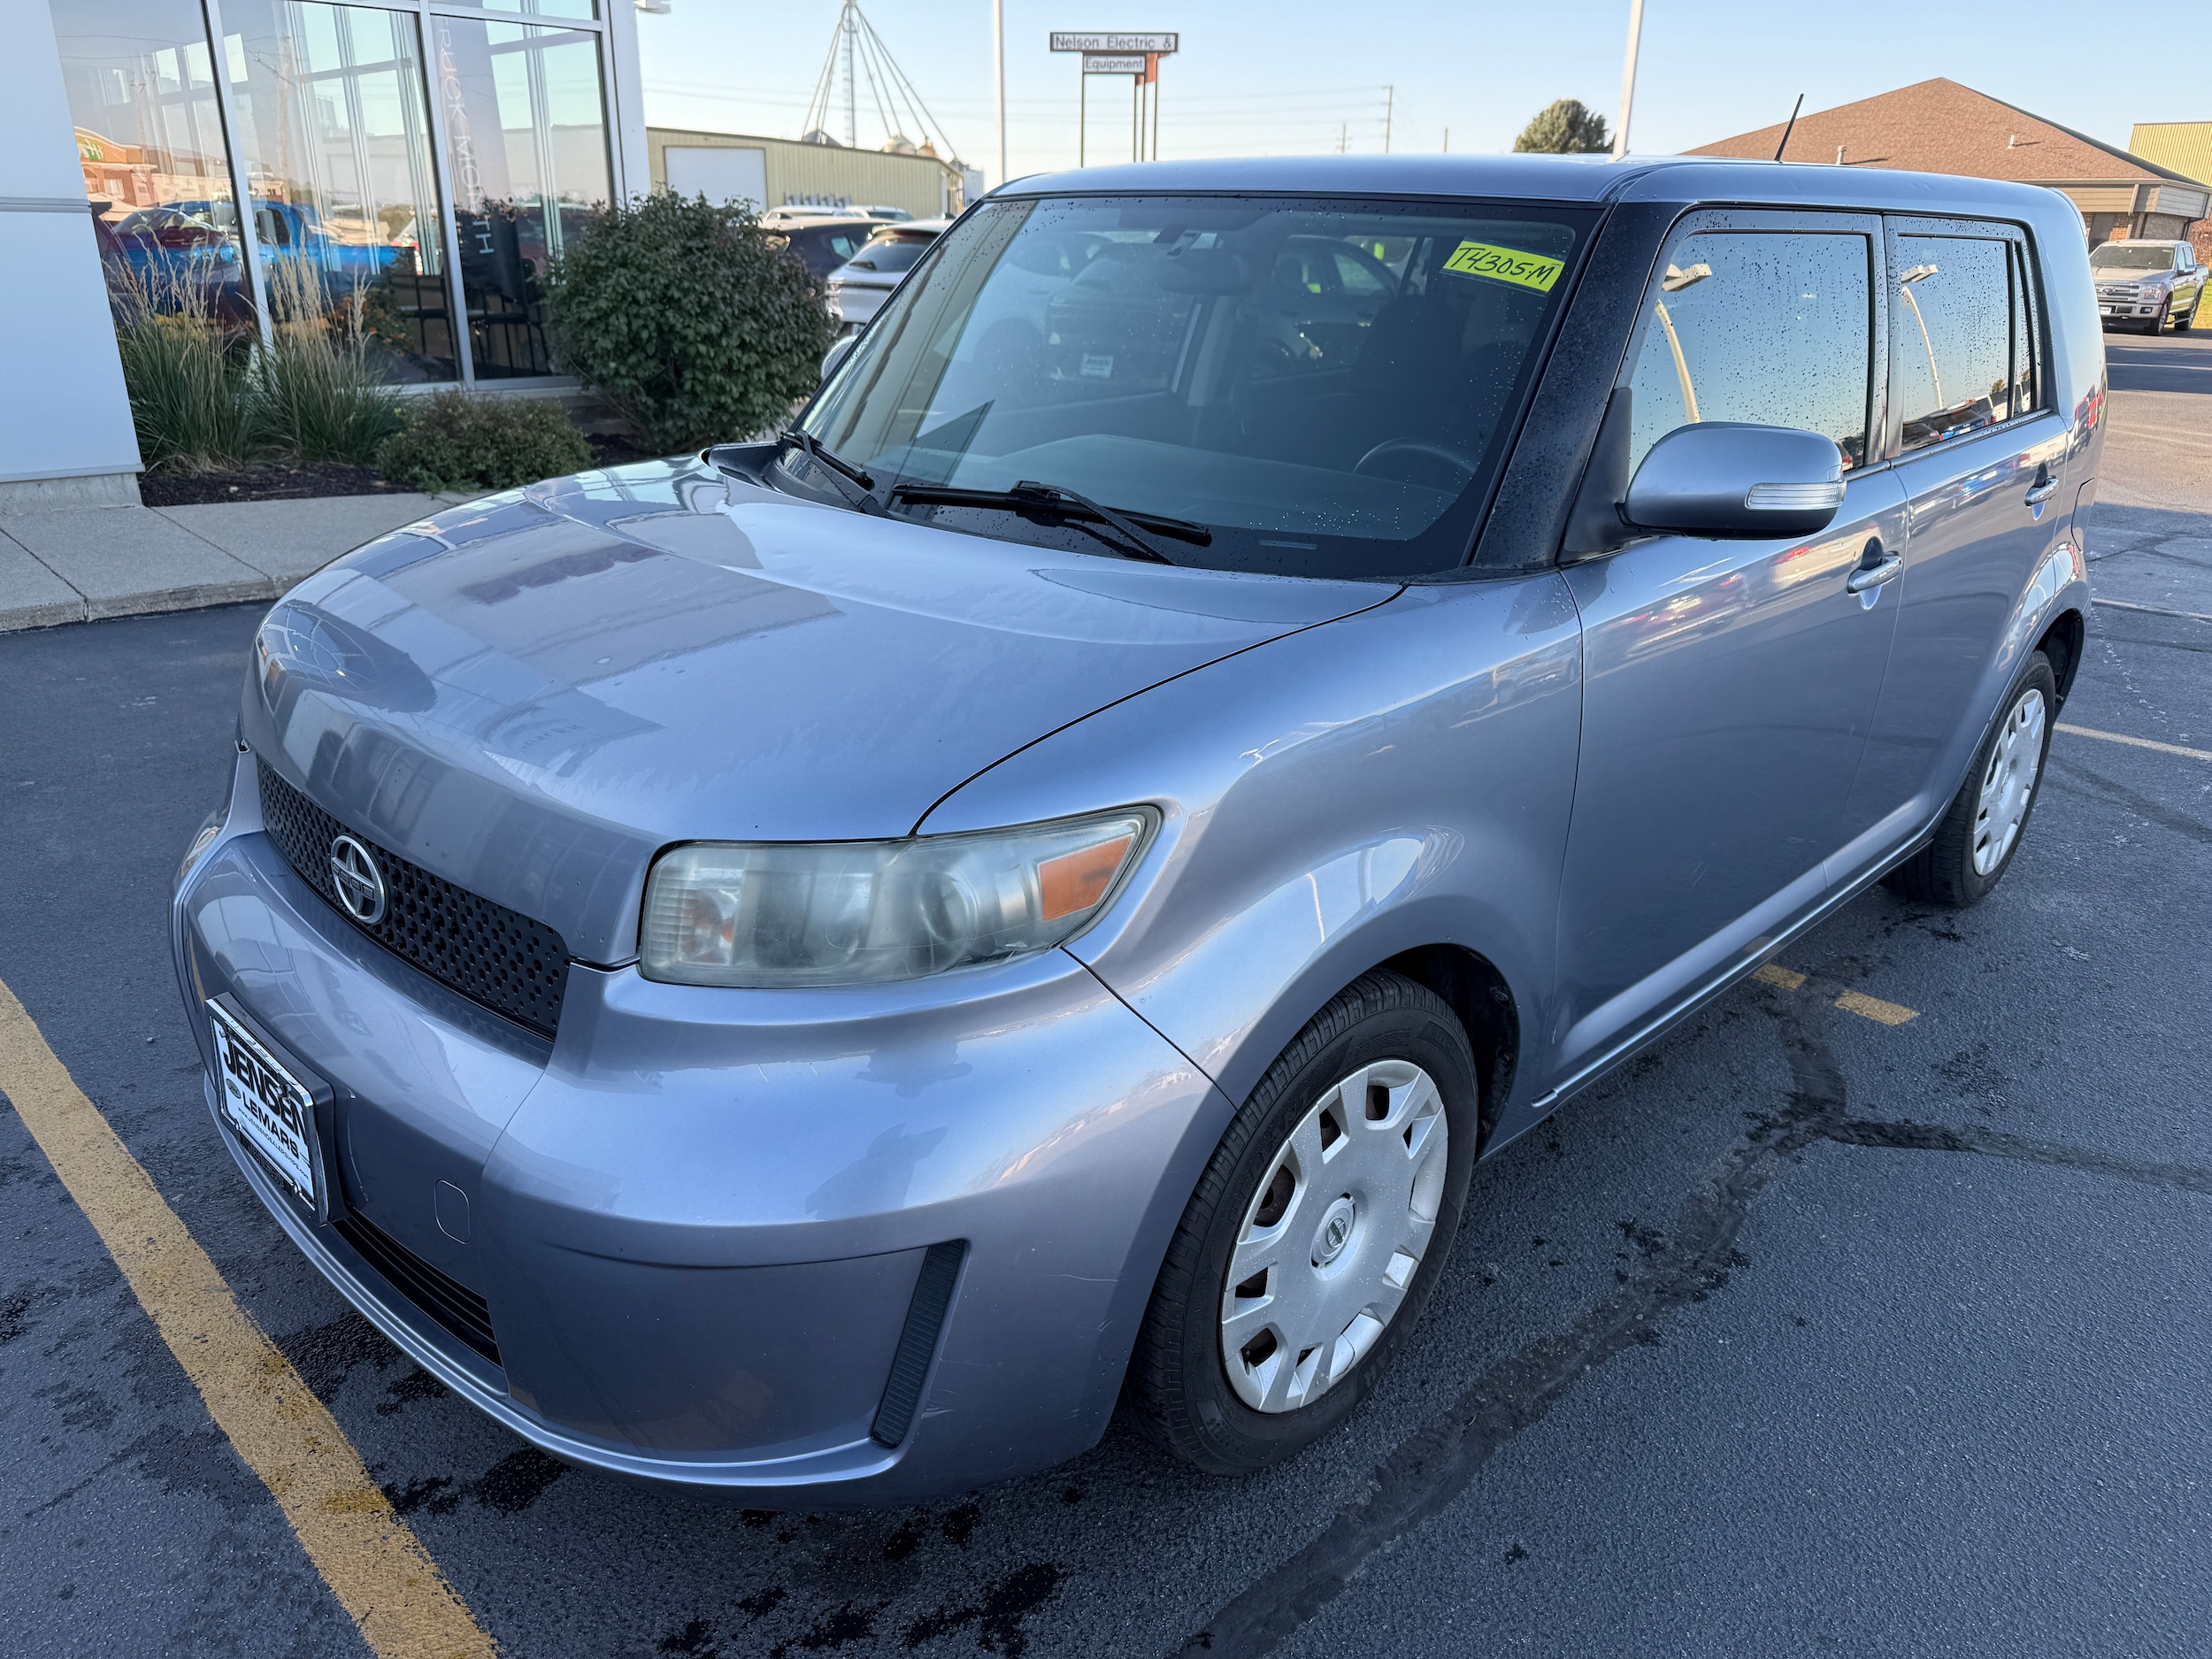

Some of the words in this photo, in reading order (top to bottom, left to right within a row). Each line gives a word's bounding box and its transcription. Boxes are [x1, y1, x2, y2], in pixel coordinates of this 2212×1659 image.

[1056, 35, 1100, 50] Nelson
[1107, 35, 1156, 50] Electric
[1164, 35, 1172, 50] &
[1086, 58, 1143, 72] Equipment
[223, 1041, 307, 1144] JENSEN
[242, 1090, 300, 1159] LEMARS
